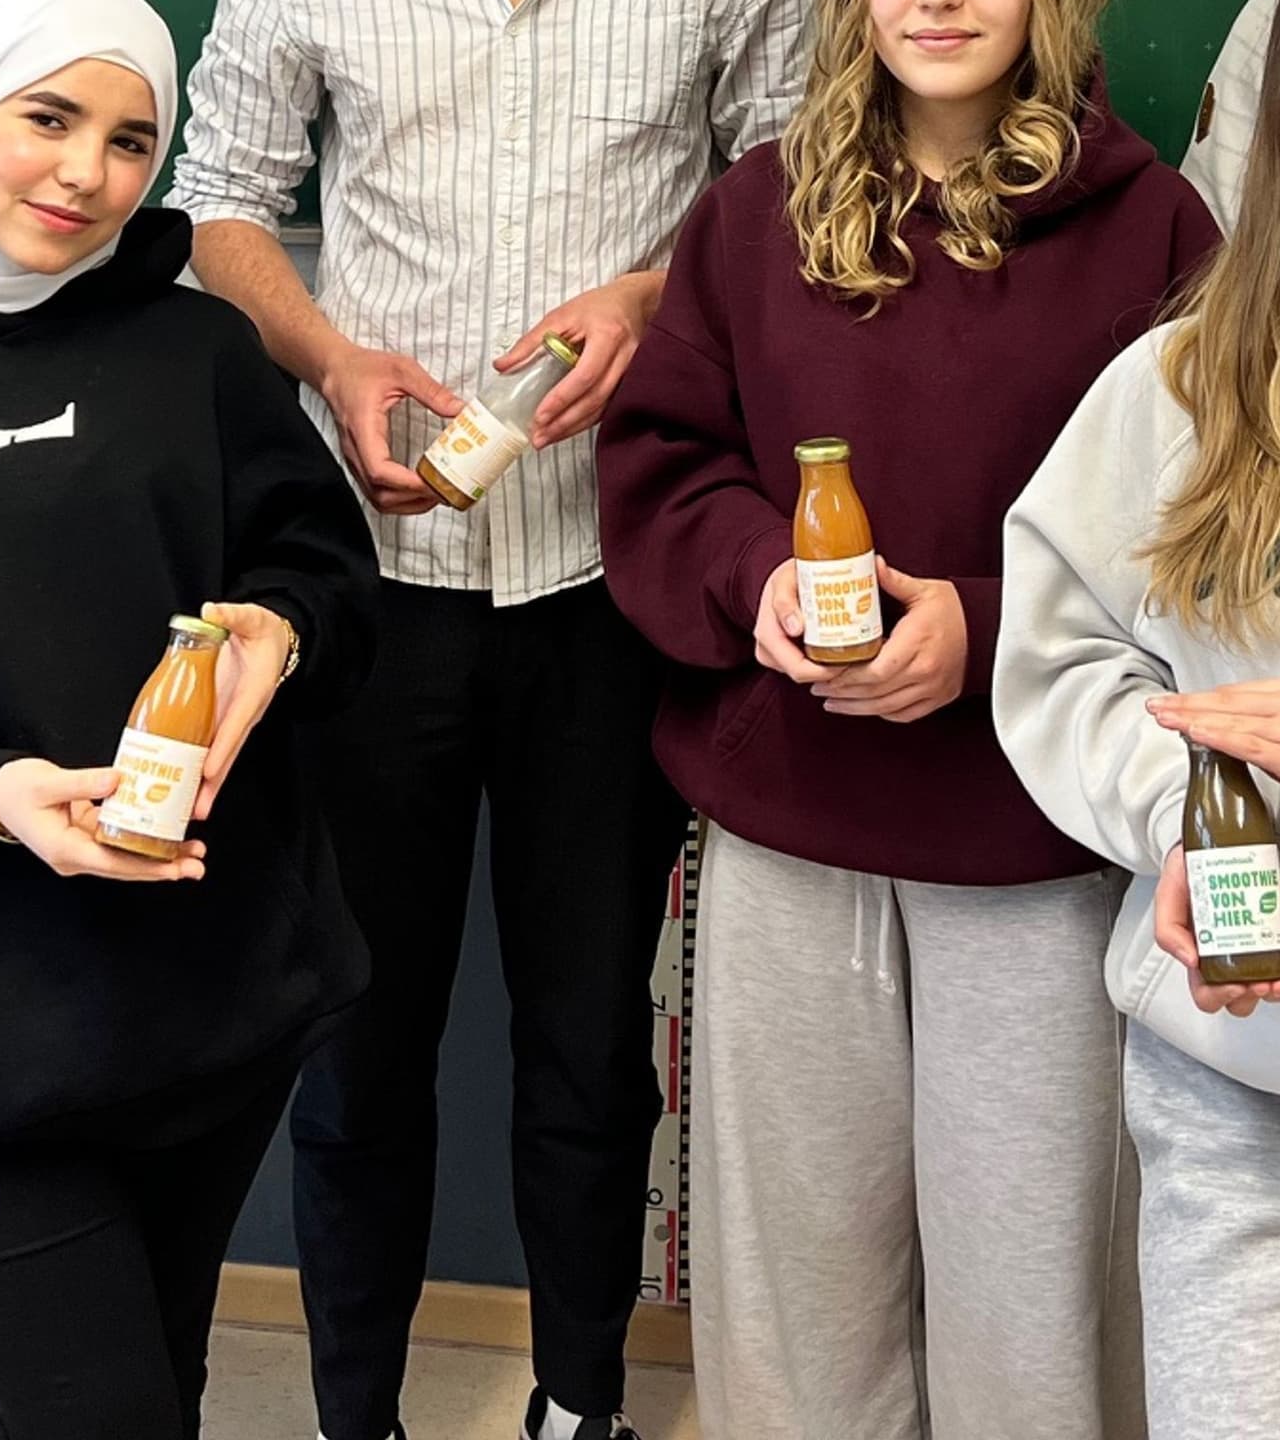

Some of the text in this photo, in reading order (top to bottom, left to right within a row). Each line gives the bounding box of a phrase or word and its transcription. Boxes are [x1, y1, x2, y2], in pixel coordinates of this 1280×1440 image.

[814, 575, 874, 596] SMOOTHIE
[816, 598, 845, 611] VON
[1208, 869, 1279, 890] SMOOTHIE
[1210, 891, 1246, 908] VON
